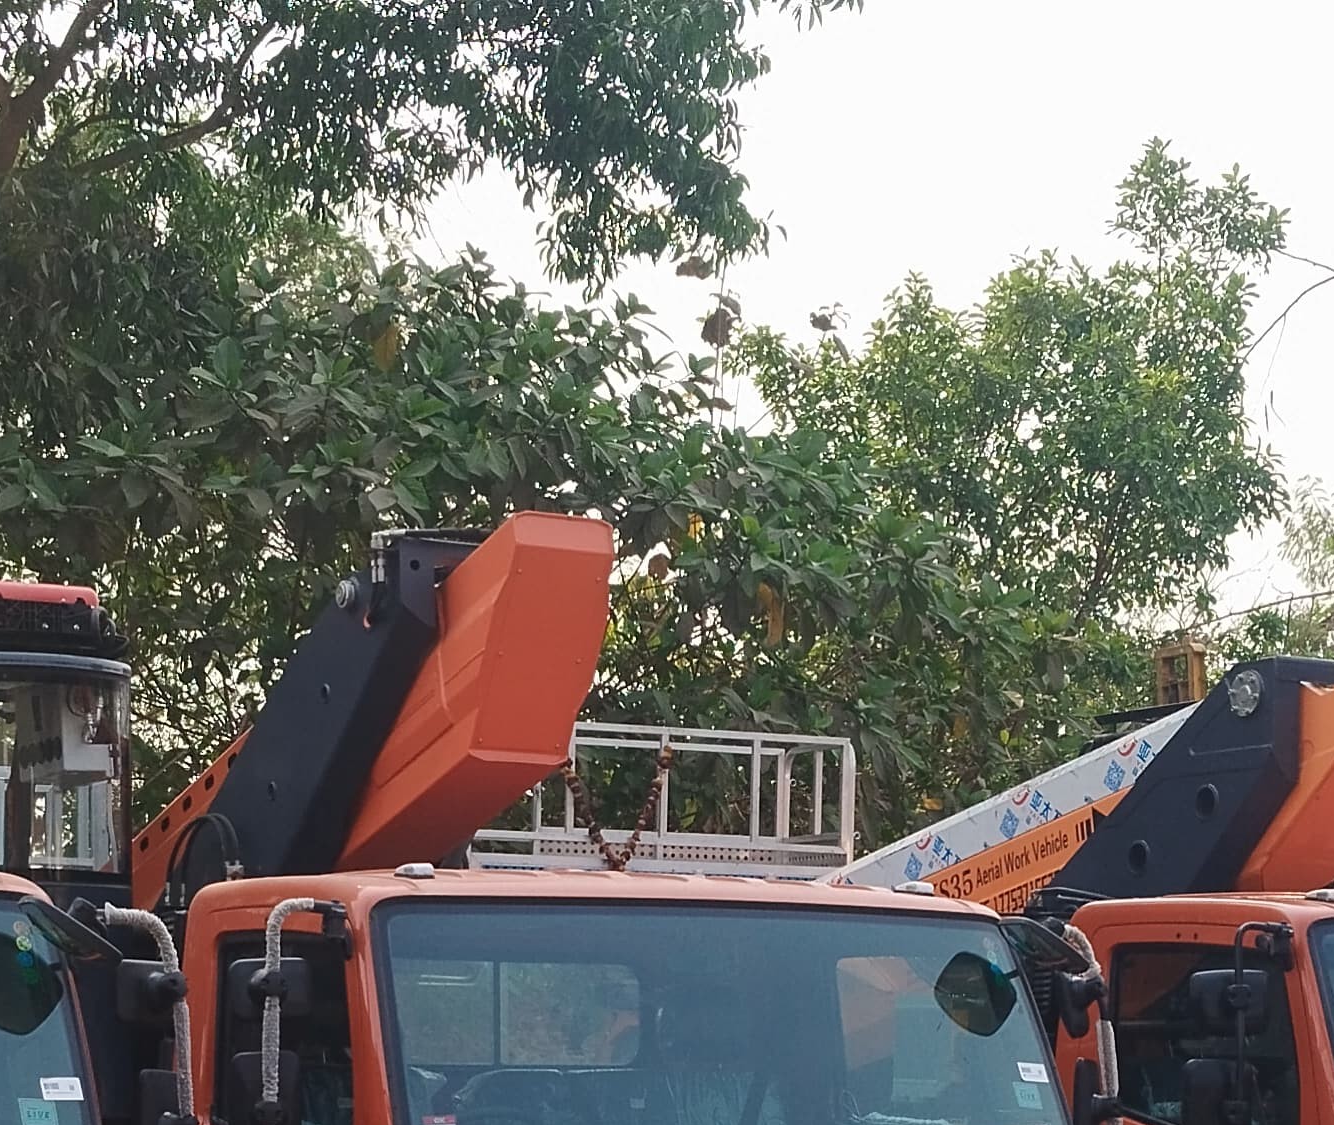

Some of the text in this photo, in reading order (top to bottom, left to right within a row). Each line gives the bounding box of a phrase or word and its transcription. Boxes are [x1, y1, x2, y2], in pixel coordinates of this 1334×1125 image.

[934, 869, 973, 899] S35
[976, 857, 1003, 889] Aerial
[1004, 846, 1031, 875] Work
[1031, 830, 1069, 862] Vehicle
